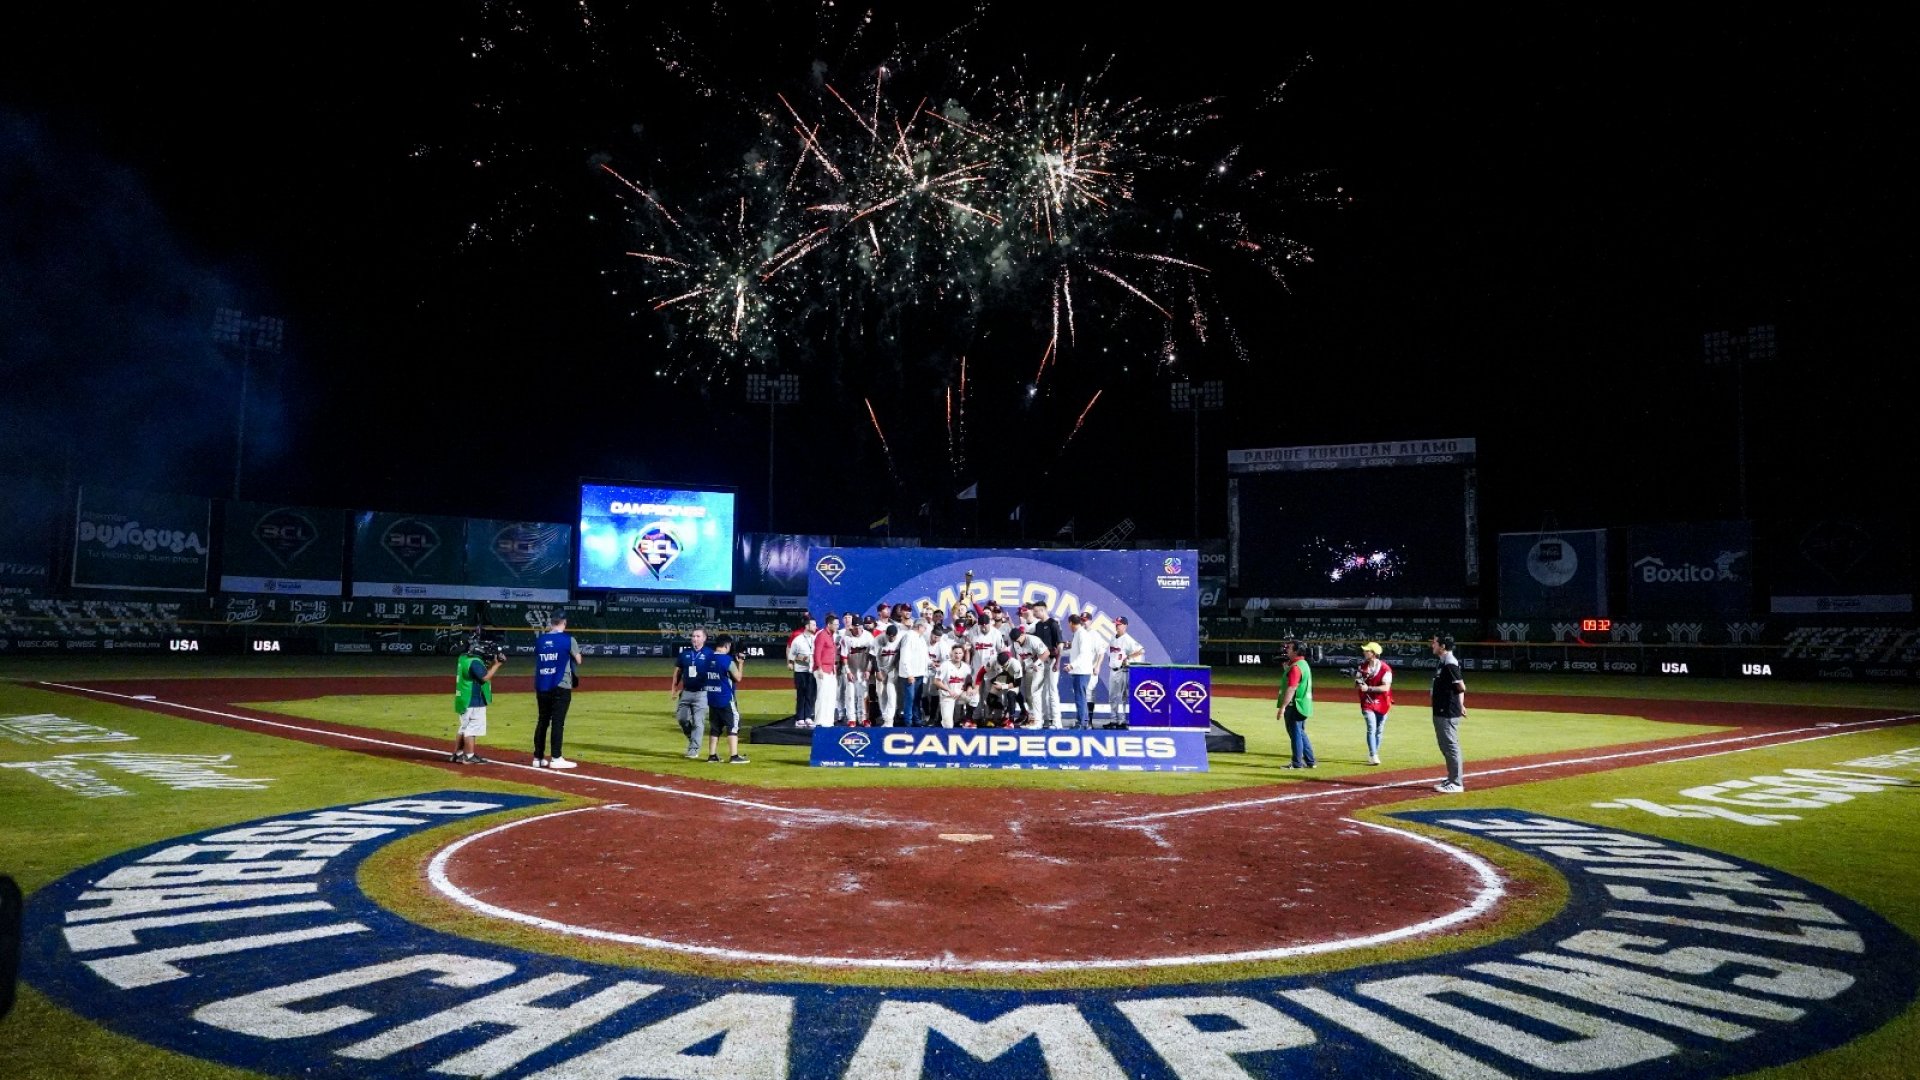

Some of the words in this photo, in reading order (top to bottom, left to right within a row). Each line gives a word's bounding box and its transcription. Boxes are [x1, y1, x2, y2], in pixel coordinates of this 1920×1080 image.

[1244, 450, 1301, 463] PARQUE
[79, 521, 208, 555] DUNOSUSA
[1642, 562, 1715, 583] Boxito
[268, 600, 276, 611] 4
[342, 601, 354, 613] 17
[374, 603, 386, 614] 18
[394, 603, 406, 614] 19
[412, 603, 424, 615] 21
[431, 604, 446, 616] 29
[453, 604, 468, 616] 34
[169, 640, 199, 651] USA
[253, 641, 281, 651] USA
[1239, 654, 1261, 664] USA
[1661, 662, 1688, 674] USA
[1742, 663, 1772, 676] USA
[883, 733, 1177, 758] CAMPEONES
[1438, 817, 1866, 954] LEAGUE
[63, 799, 504, 990] BASEBALL
[193, 929, 1857, 1080] CHAMPIONS
